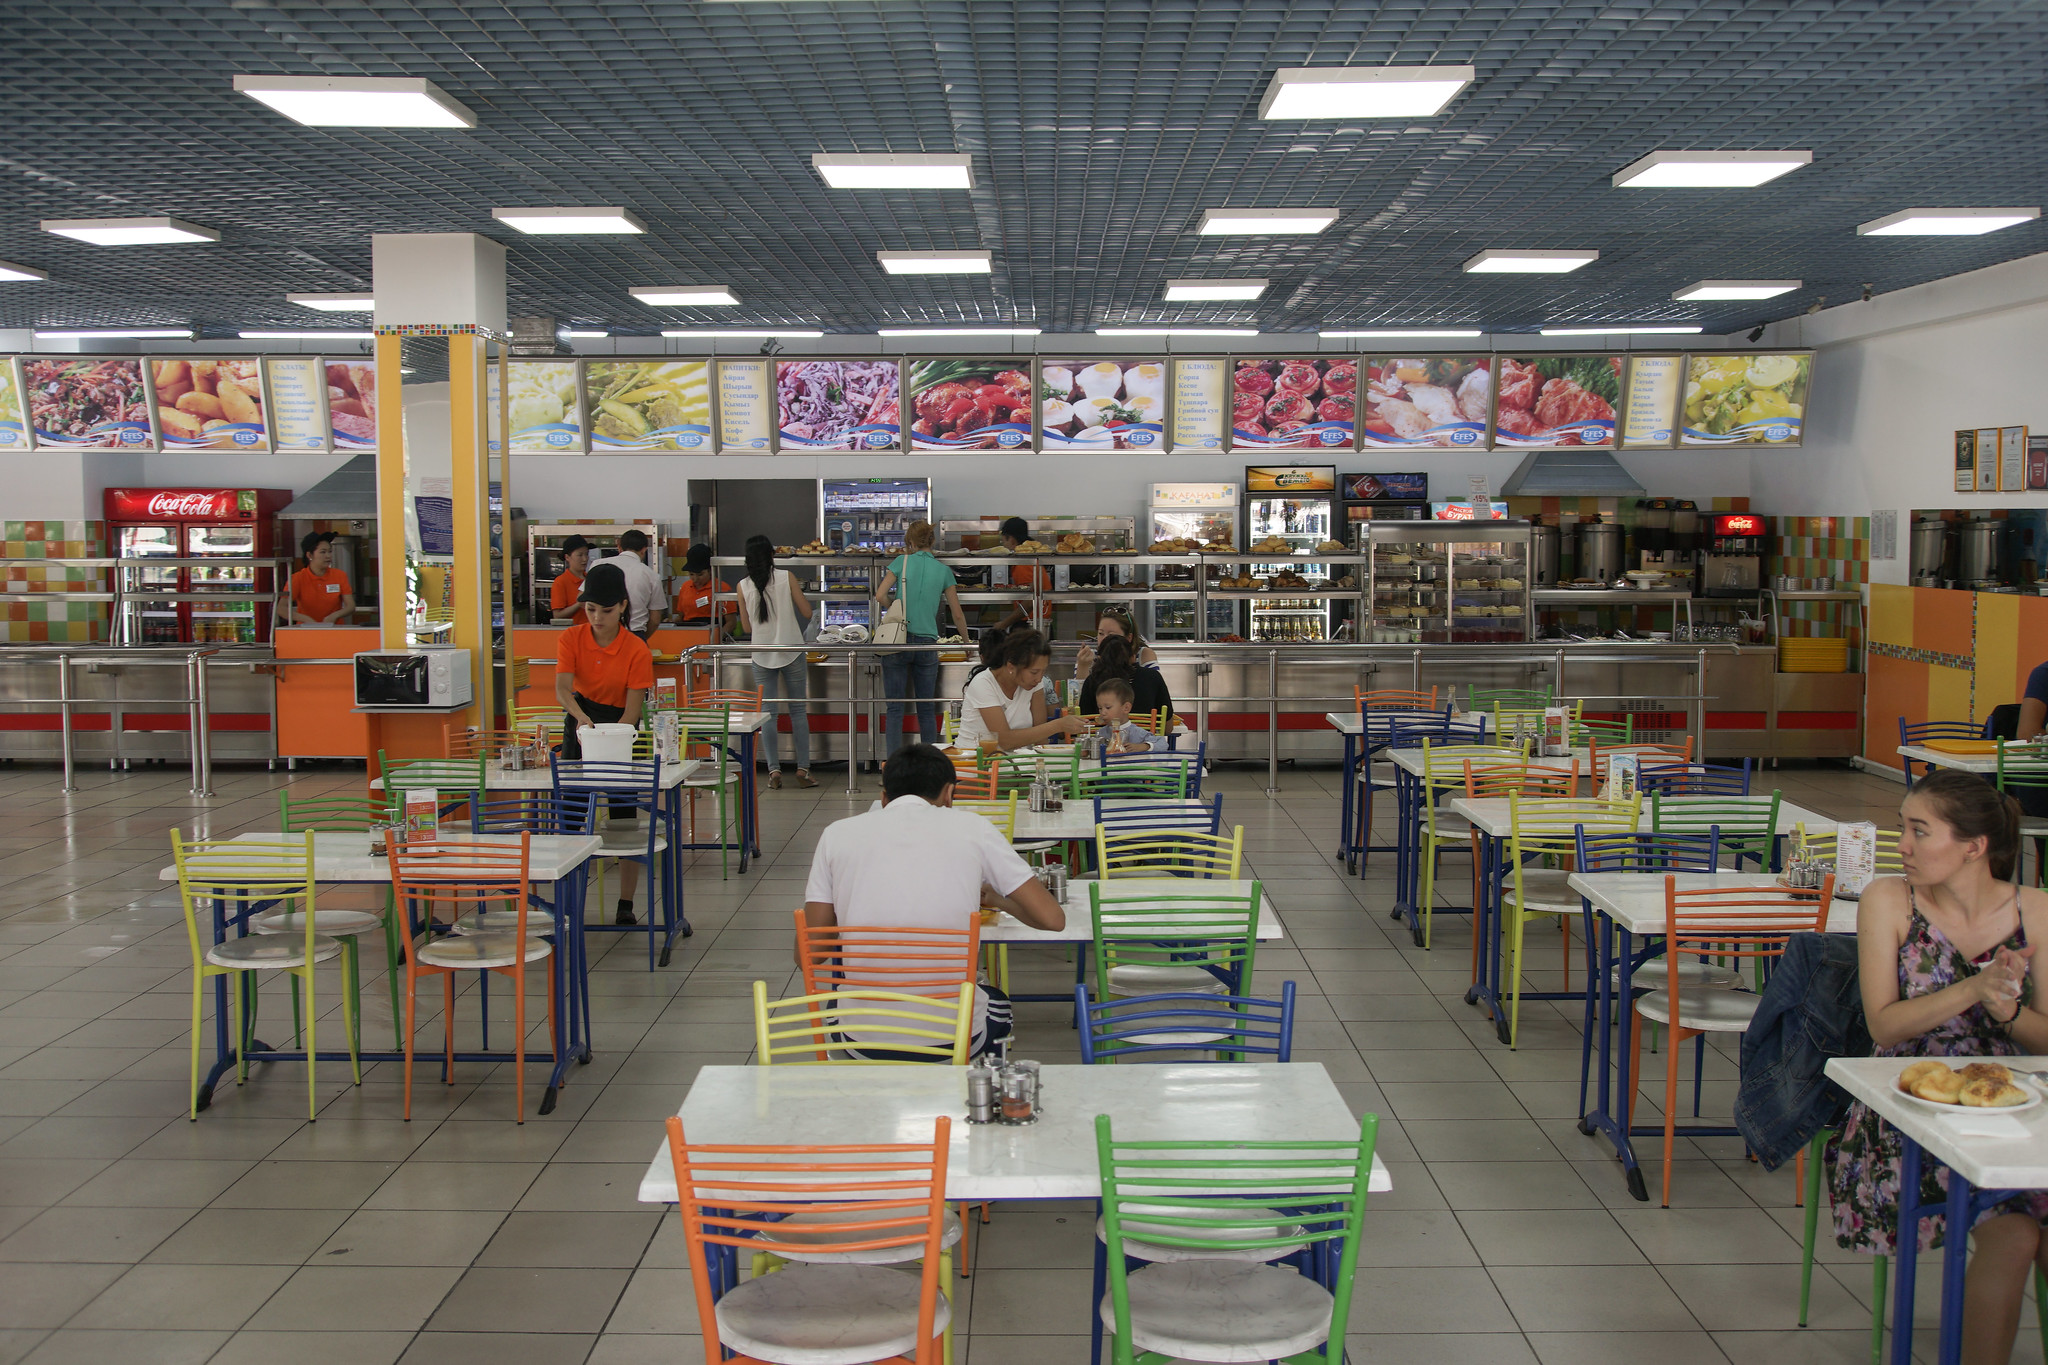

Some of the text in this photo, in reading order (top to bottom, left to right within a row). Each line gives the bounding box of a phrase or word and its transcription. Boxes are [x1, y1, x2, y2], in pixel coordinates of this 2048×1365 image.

[122, 431, 143, 440] EFES
[725, 427, 743, 435] Кофе
[1323, 431, 1344, 440] EFES
[1583, 429, 1604, 438] EFES
[1769, 427, 1790, 436] EFES
[0, 432, 16, 440] FES
[236, 432, 257, 441] EFES
[549, 434, 571, 443] EFES
[679, 434, 700, 443] EFES
[869, 433, 892, 442] EFES
[1000, 433, 1022, 442] EFES
[1131, 433, 1152, 441] EFES
[1453, 431, 1474, 441] EFES
[1473, 494, 1489, 503] -15%
[148, 493, 216, 516] Coca-Cola
[1728, 519, 1752, 529] Coca-Cola
